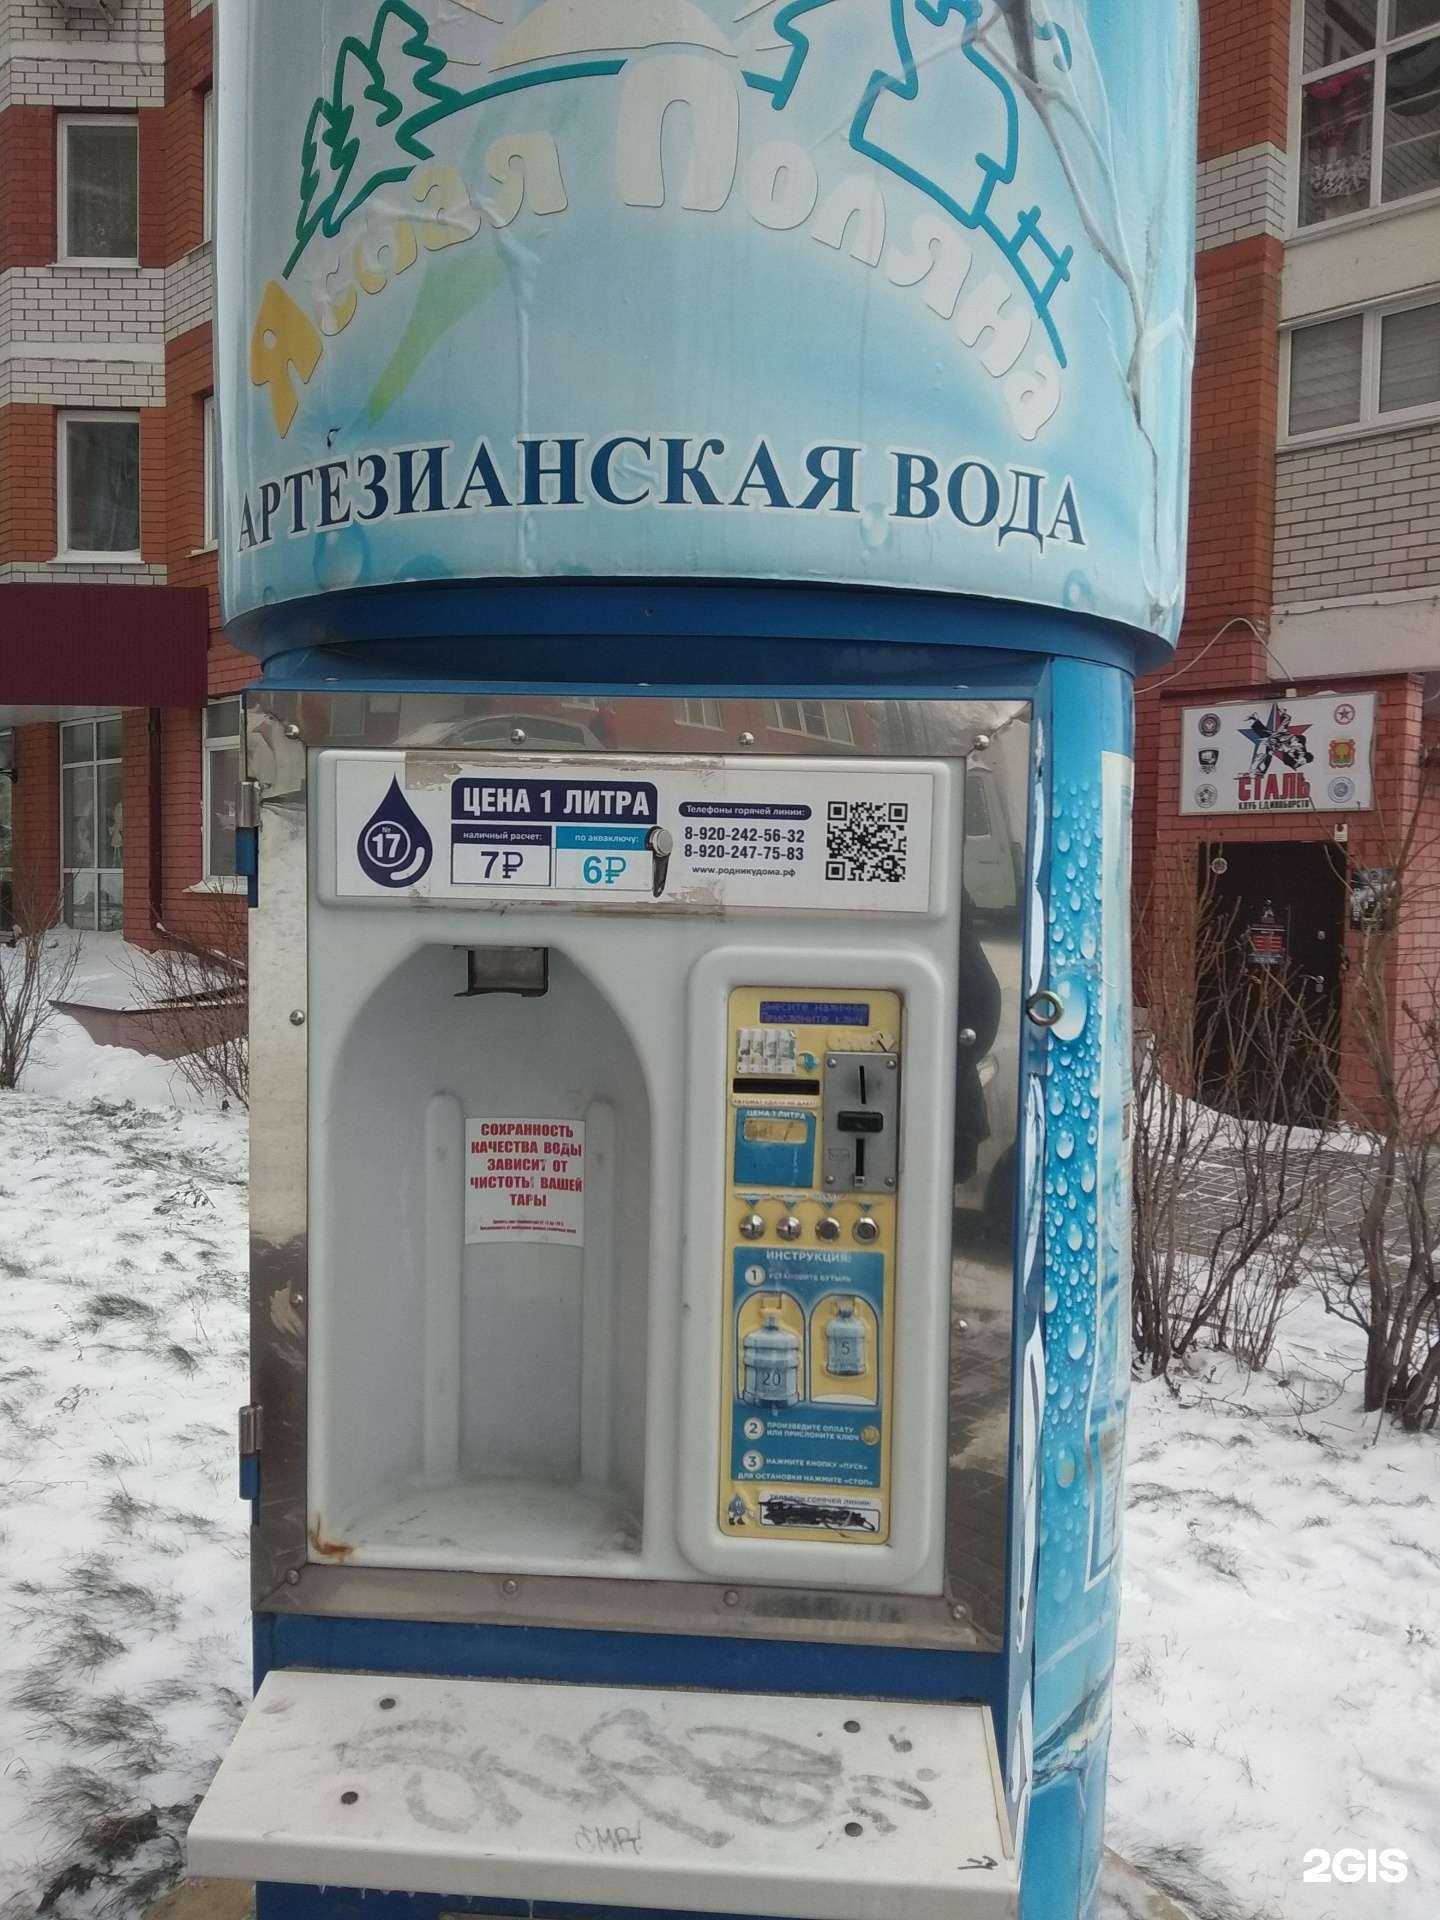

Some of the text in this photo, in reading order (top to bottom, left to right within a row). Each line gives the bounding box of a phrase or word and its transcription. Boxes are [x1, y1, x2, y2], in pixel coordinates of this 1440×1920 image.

[237, 436, 1086, 554] АРТЕЗИАНСКАЯ ВОДА
[463, 787, 650, 816] ЦЕНА 1 ЛИТРА
[686, 804, 806, 818] Телефоны горячей линии:
[463, 831, 542, 842] наличный расчет:
[575, 834, 639, 844] по акваключу:
[684, 826, 805, 843] 8-920-242-56-32
[372, 833, 400, 858] 17
[684, 844, 804, 861] 8-920-247-75-83
[691, 866, 796, 878] www.родникудома.рф
[481, 1123, 574, 1138] СОХРАННОСТЬ
[471, 1141, 582, 1156] КАЧЕСТВА ВОДЫ
[487, 1159, 568, 1172] ЗАВИСИТ ОТ
[540, 1177, 582, 1192] ВАШЕЙ
[510, 1194, 547, 1207] ТАРЫ
[751, 1270, 757, 1280] 1
[841, 1341, 850, 1355] 5
[762, 1372, 781, 1386] 20
[749, 1422, 758, 1434] 2
[748, 1456, 757, 1467] 3
[804, 1475, 842, 1484] НАЖМИТЕ
